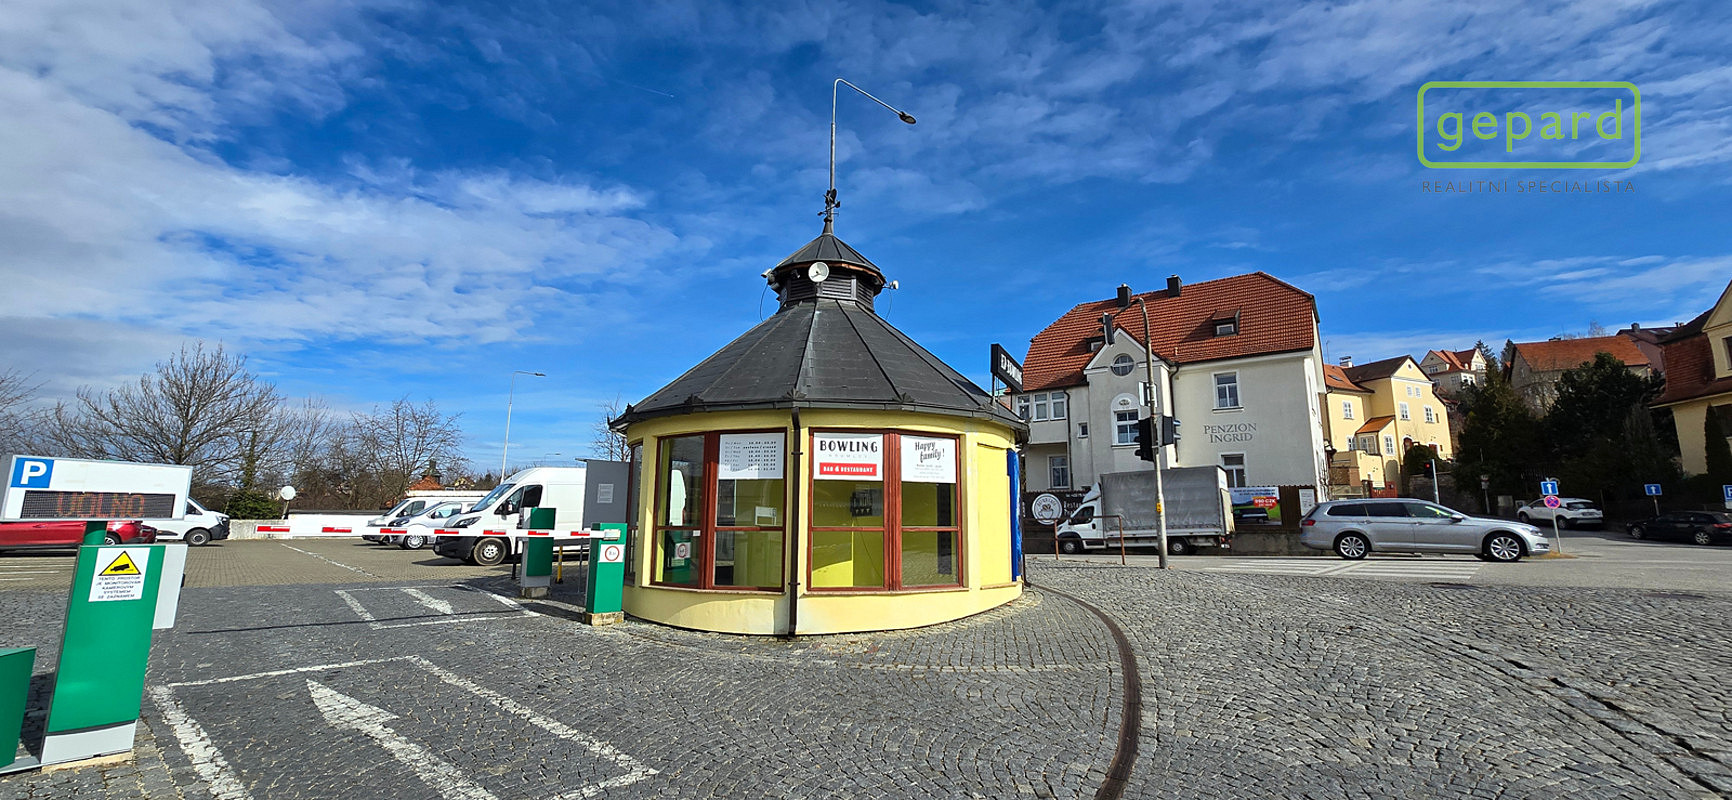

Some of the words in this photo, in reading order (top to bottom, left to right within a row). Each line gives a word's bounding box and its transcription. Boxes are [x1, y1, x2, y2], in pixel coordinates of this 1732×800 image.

[1203, 422, 1257, 435] PENZION
[1210, 432, 1253, 444] INGRID
[819, 439, 878, 453] BOWLING
[914, 441, 936, 451] Happy
[20, 461, 47, 485] P
